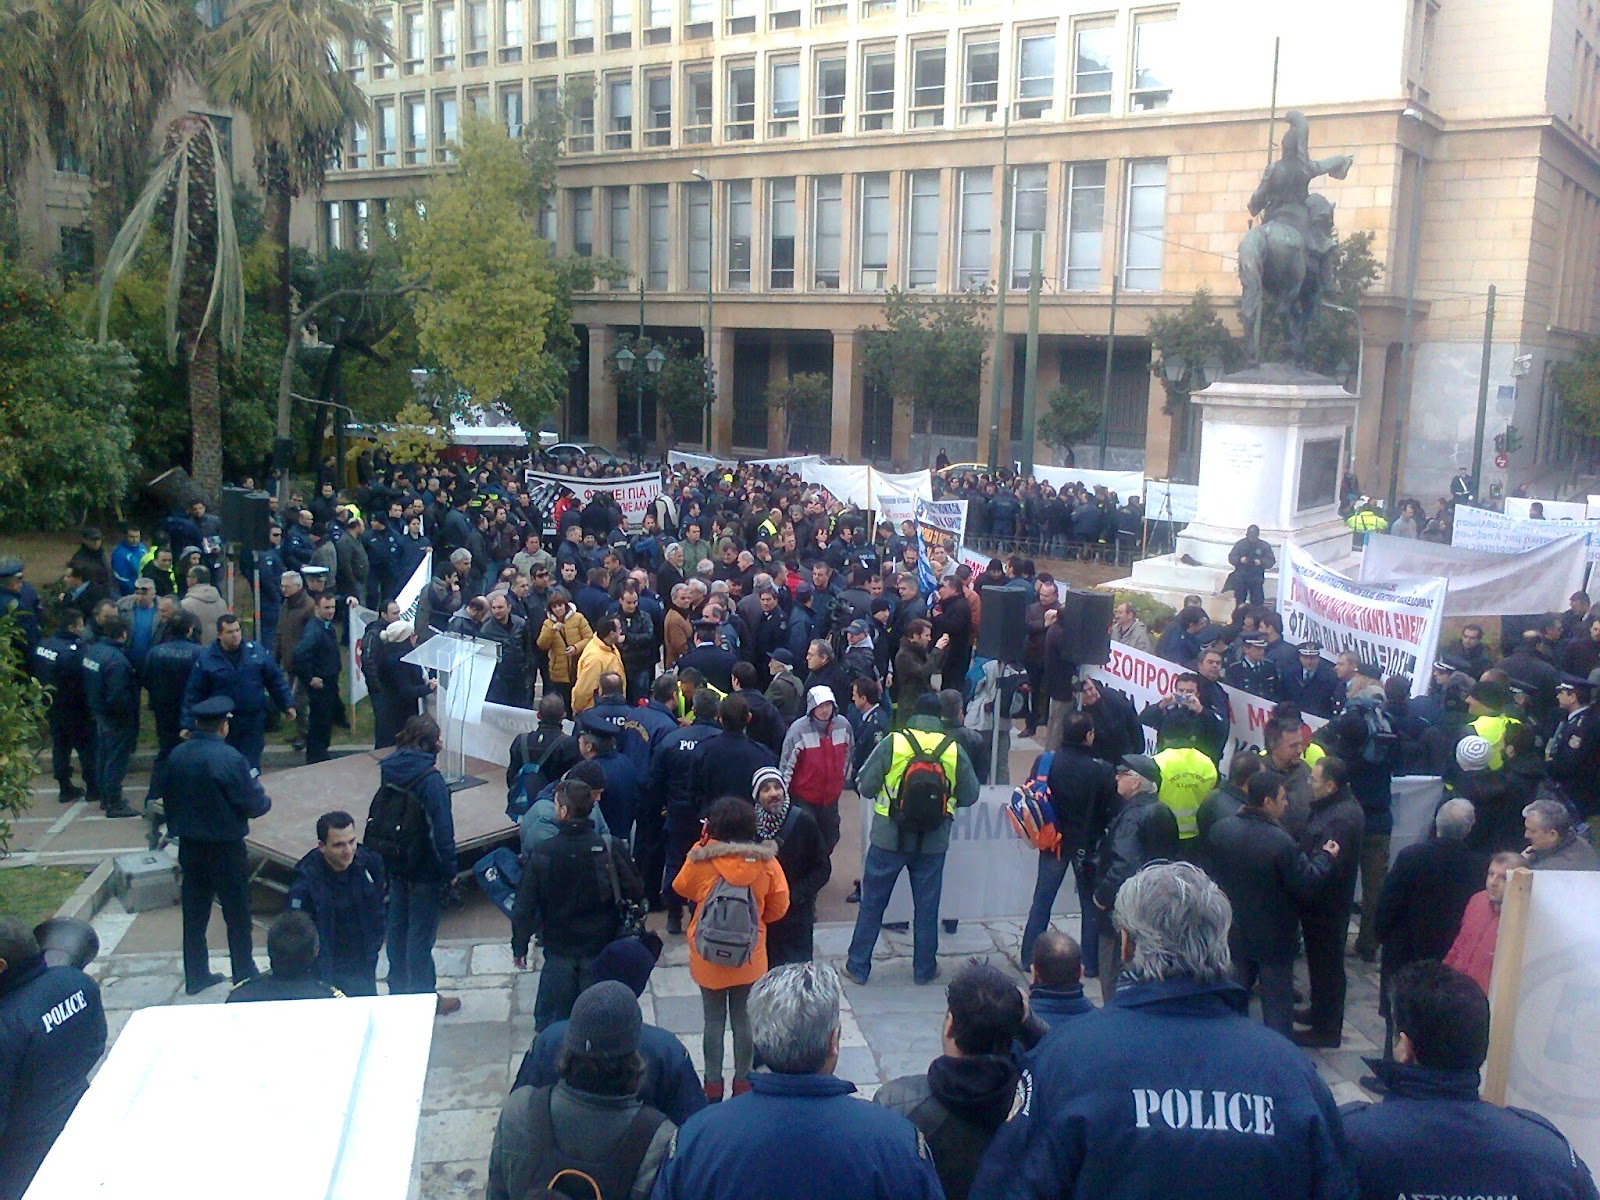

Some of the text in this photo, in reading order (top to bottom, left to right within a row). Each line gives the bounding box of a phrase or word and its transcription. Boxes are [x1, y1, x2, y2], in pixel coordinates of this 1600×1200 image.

[628, 485, 647, 500] ΠΙΑ
[41, 989, 88, 1034] POLICE
[1132, 1088, 1276, 1136] POLICE
